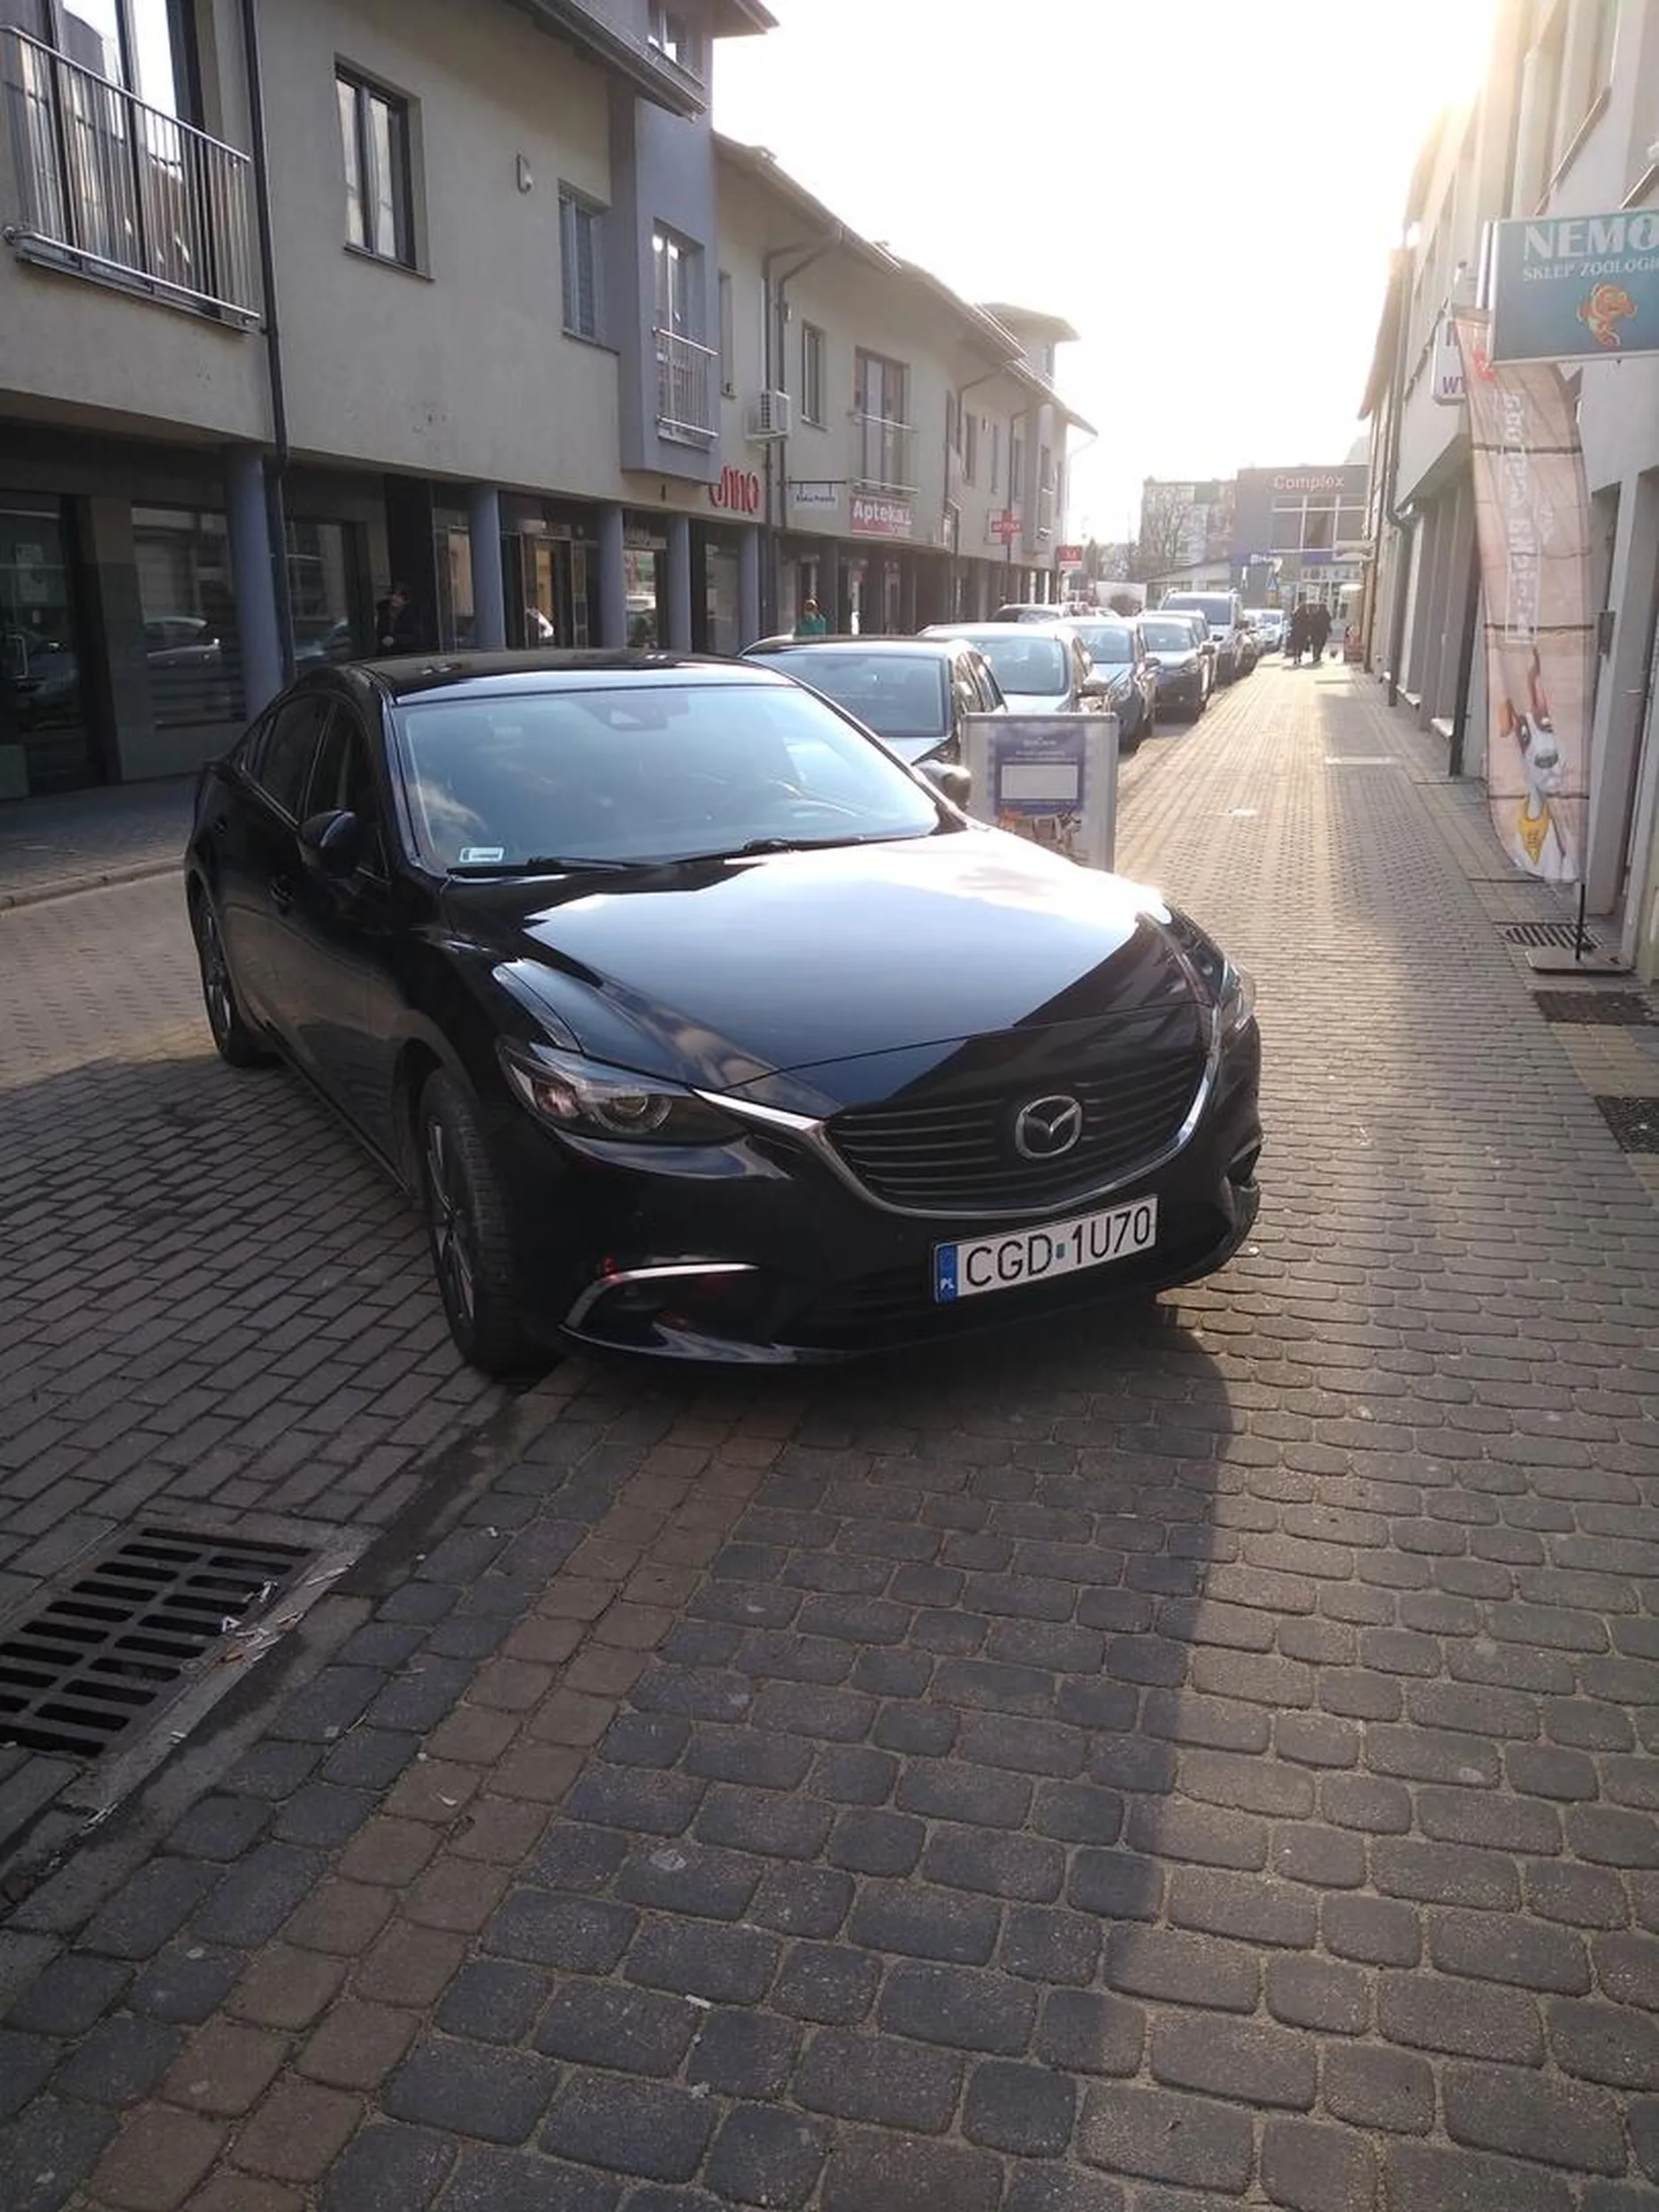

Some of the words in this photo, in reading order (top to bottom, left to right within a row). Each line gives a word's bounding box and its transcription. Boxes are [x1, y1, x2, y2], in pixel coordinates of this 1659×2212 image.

[1524, 212, 1659, 260] NEMO
[966, 1233, 1053, 1286] CGD
[1071, 1206, 1150, 1265] 1U70
